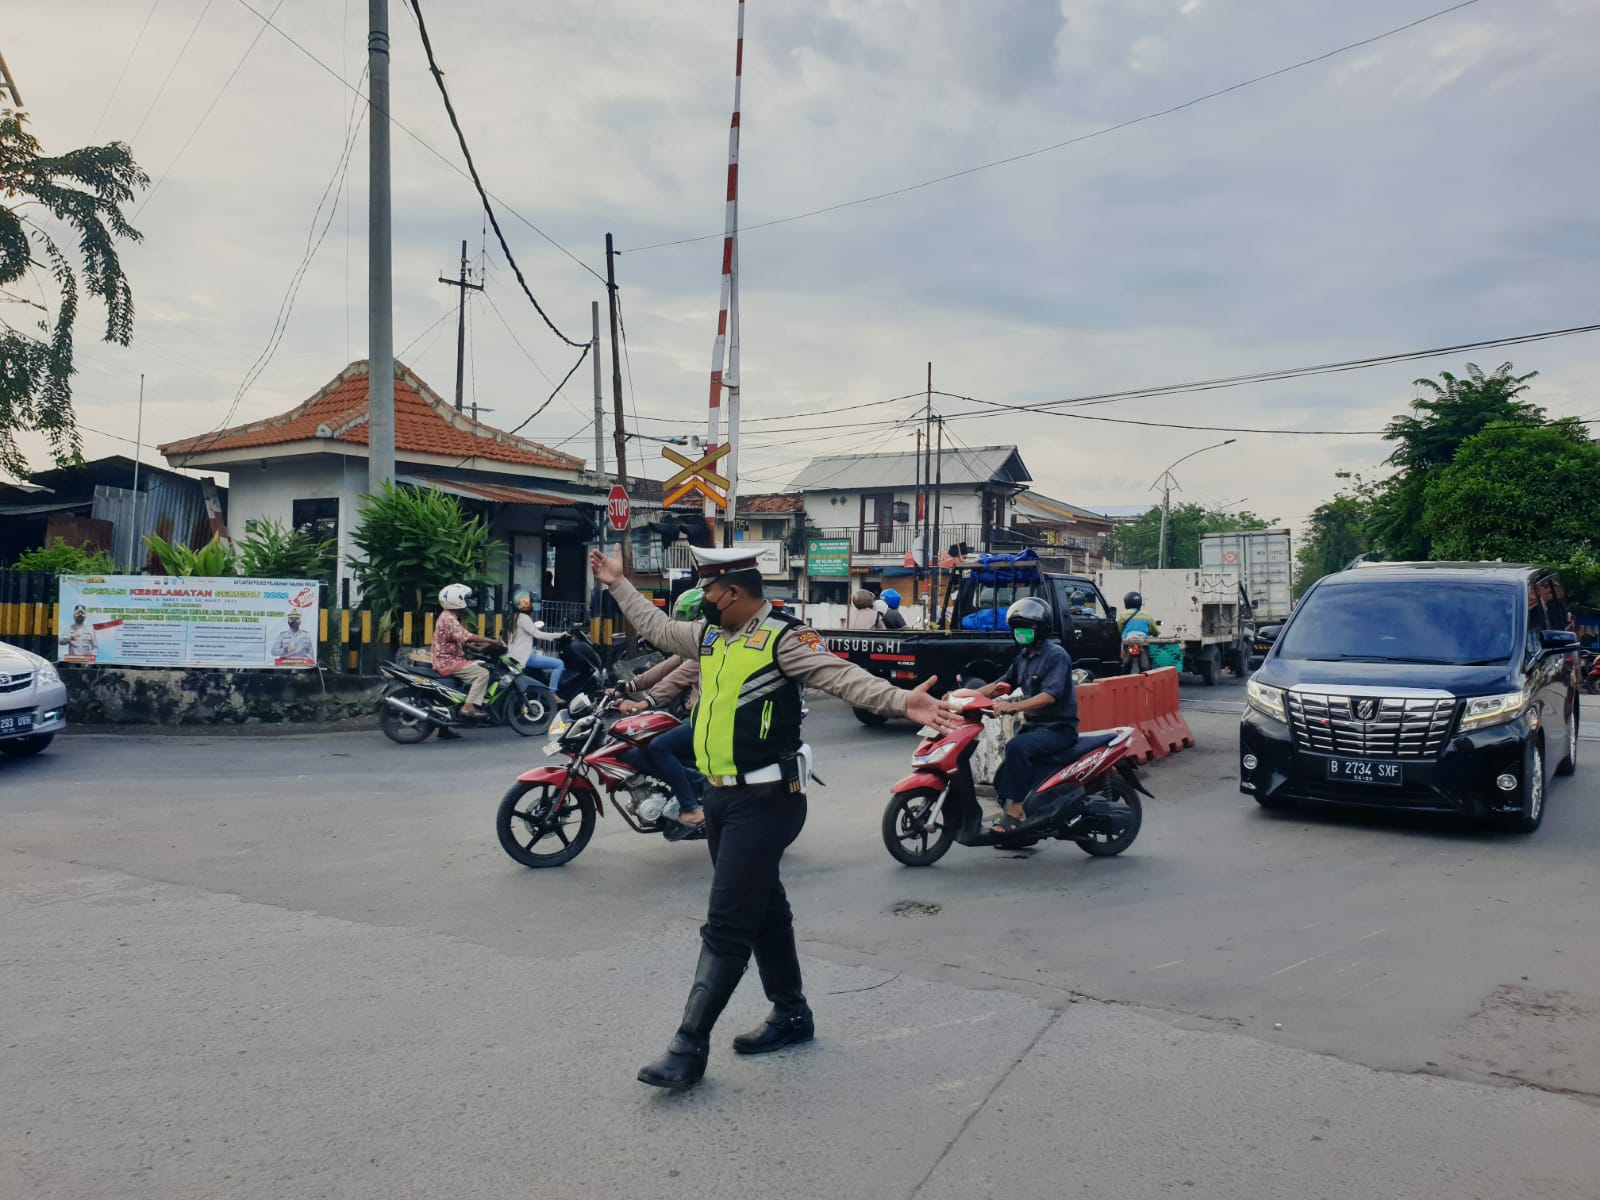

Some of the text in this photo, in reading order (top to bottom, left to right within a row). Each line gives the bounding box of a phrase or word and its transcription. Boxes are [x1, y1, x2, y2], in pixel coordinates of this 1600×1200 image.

[610, 498, 628, 517] STOP
[82, 587, 127, 596] OPERASI
[130, 588, 212, 598] KESELAMATAN
[215, 590, 261, 599] SEMERU
[822, 638, 901, 653] MITSUBISHI
[1331, 760, 1399, 777] B 2734 SXF
